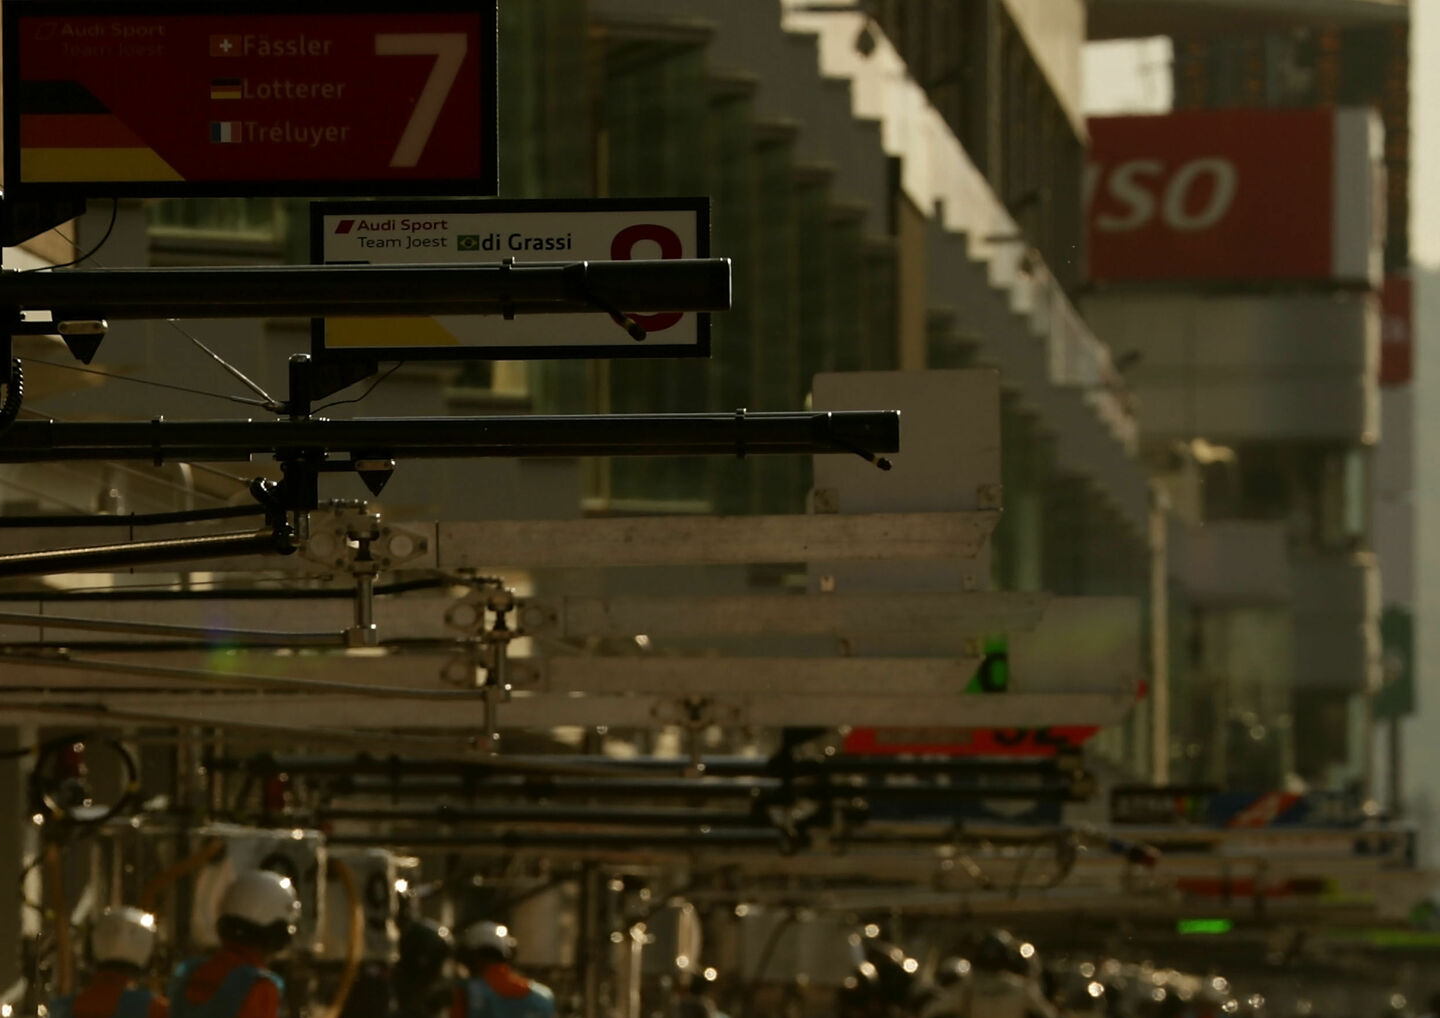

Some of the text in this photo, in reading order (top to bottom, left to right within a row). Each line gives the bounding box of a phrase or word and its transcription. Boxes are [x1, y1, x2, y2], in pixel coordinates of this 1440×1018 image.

[61, 23, 166, 40] Audi Sport
[244, 35, 333, 56] Fässler
[243, 79, 347, 99] Lotterer
[375, 33, 468, 168] 7
[245, 121, 351, 147] Tréluyer
[357, 219, 448, 233] Audi Sport
[357, 235, 448, 249] Team Joest
[482, 232, 572, 251] di Grassi
